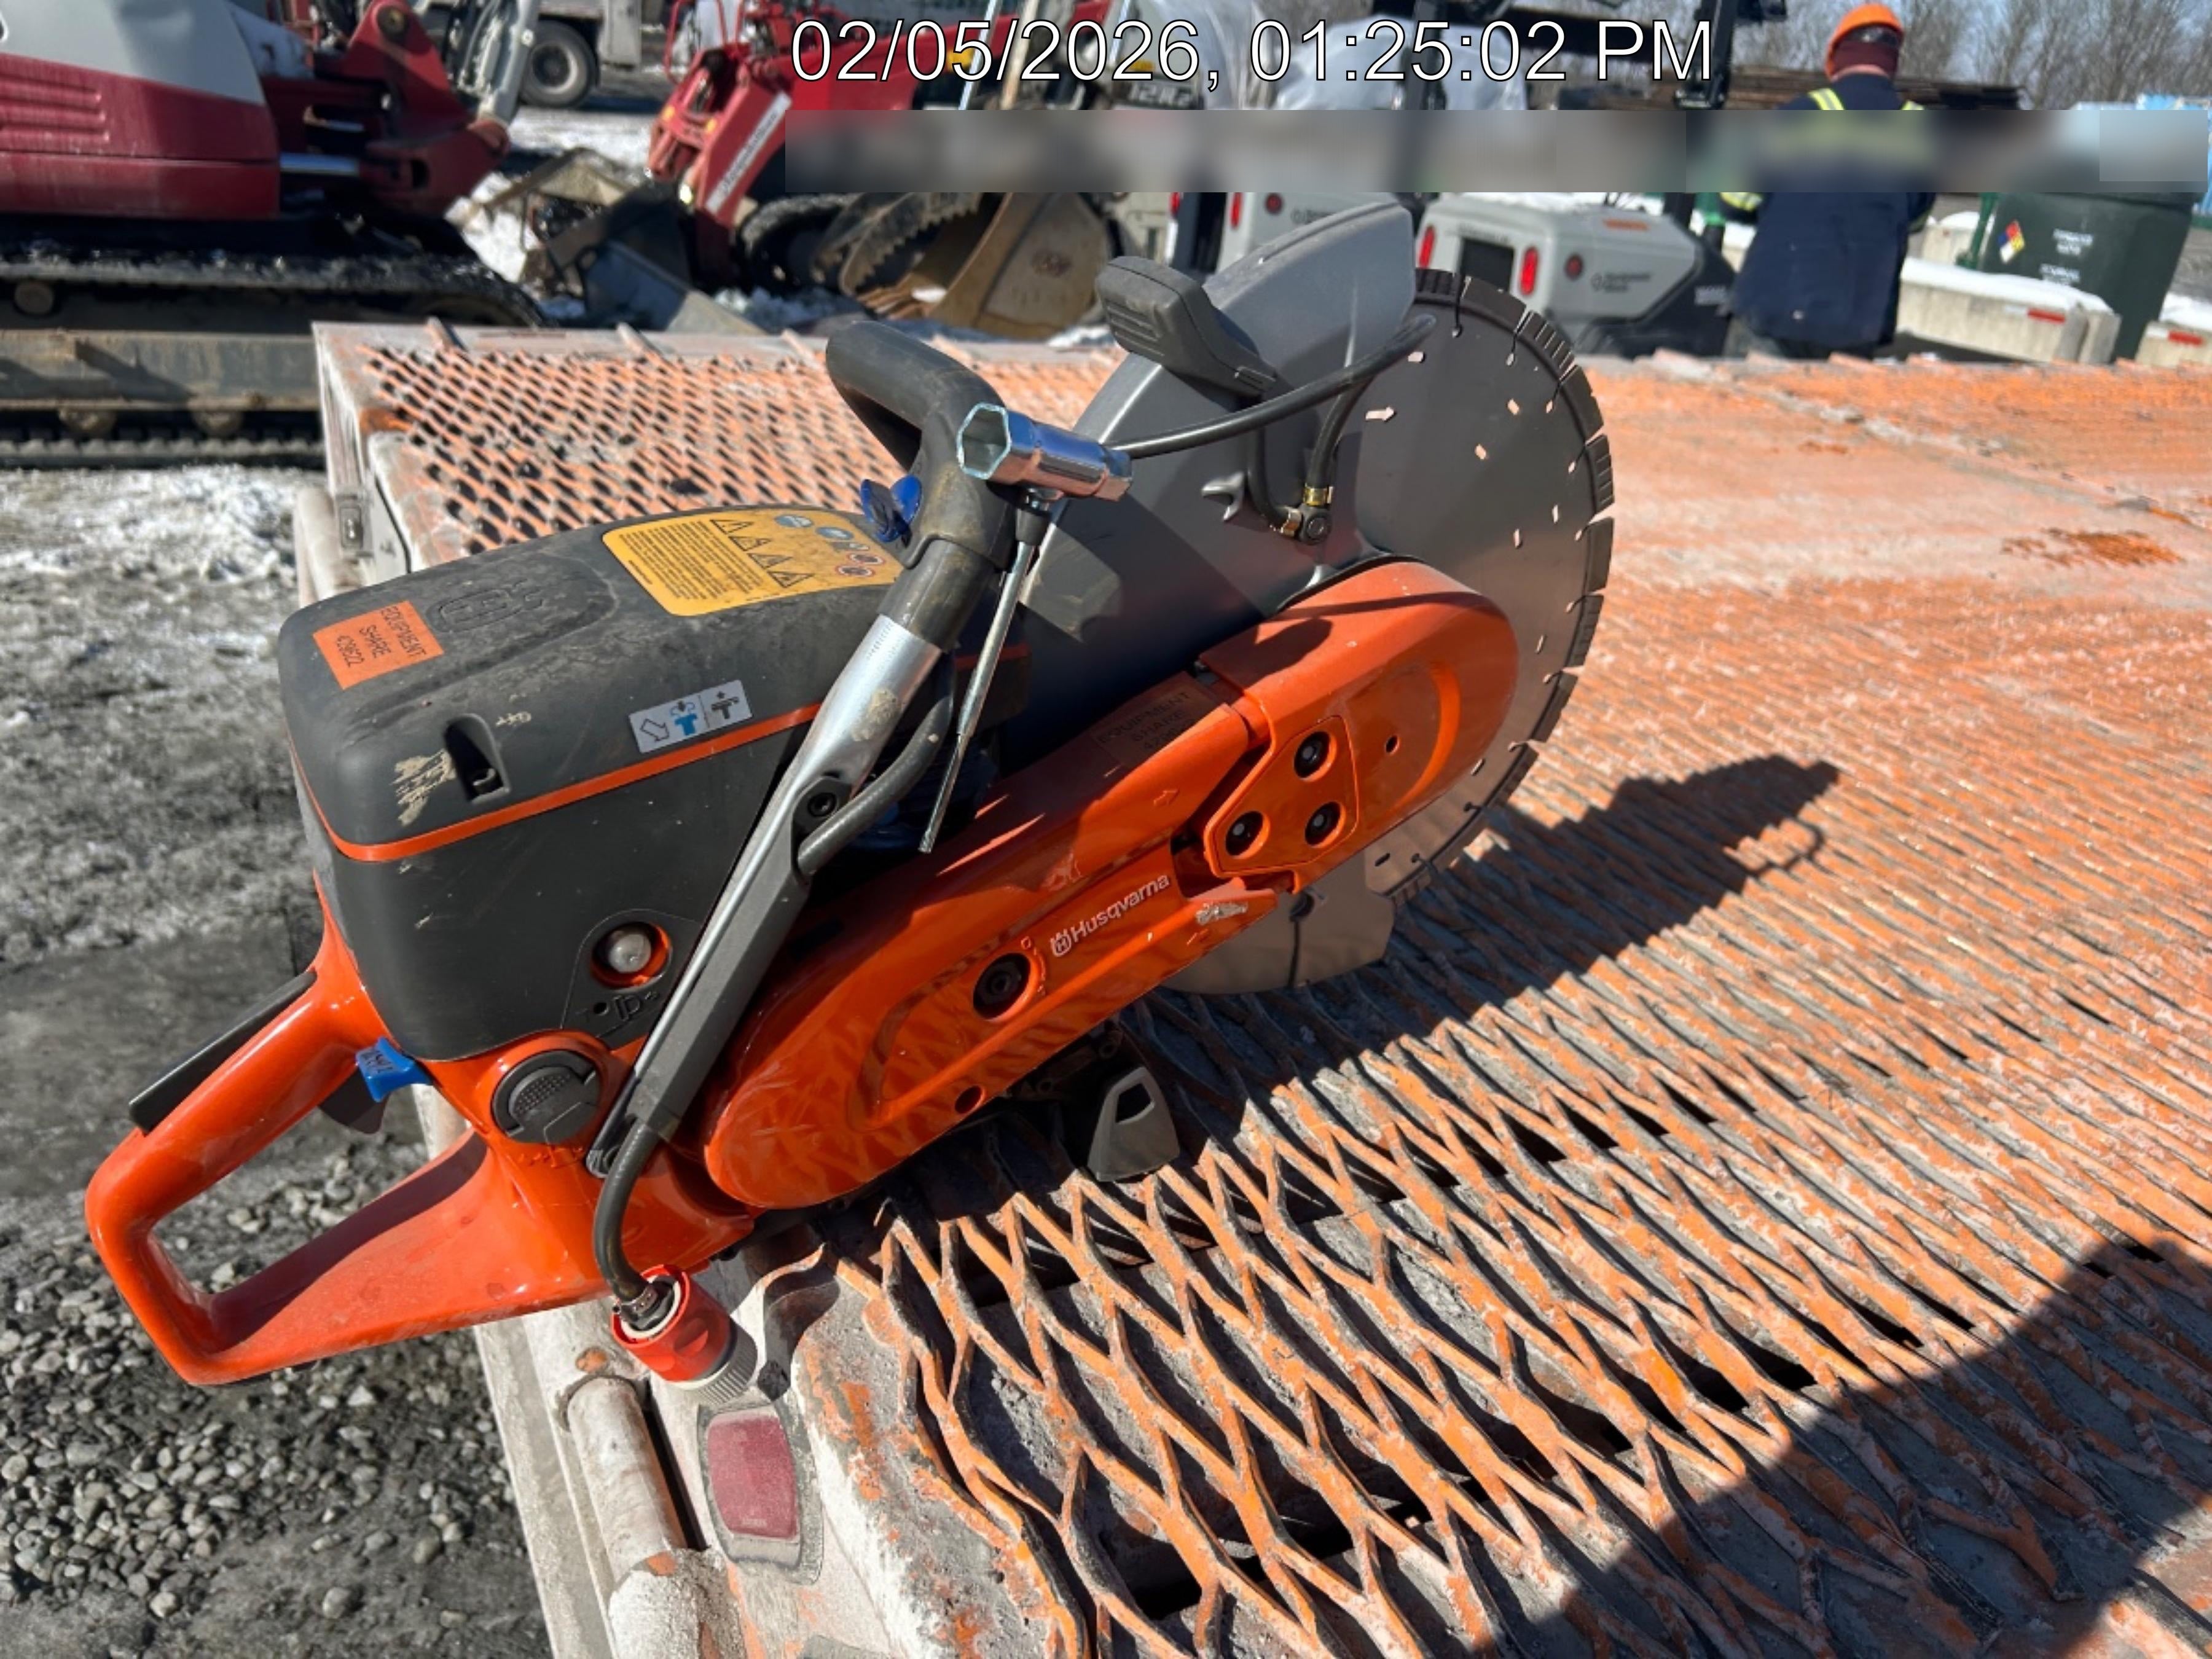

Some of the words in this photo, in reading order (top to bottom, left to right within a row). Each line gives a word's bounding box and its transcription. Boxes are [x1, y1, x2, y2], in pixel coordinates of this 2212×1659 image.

[359, 624, 391, 659] SHARE
[380, 606, 427, 657] EQUIPMENT
[1070, 874, 1170, 943] Husqvarna
